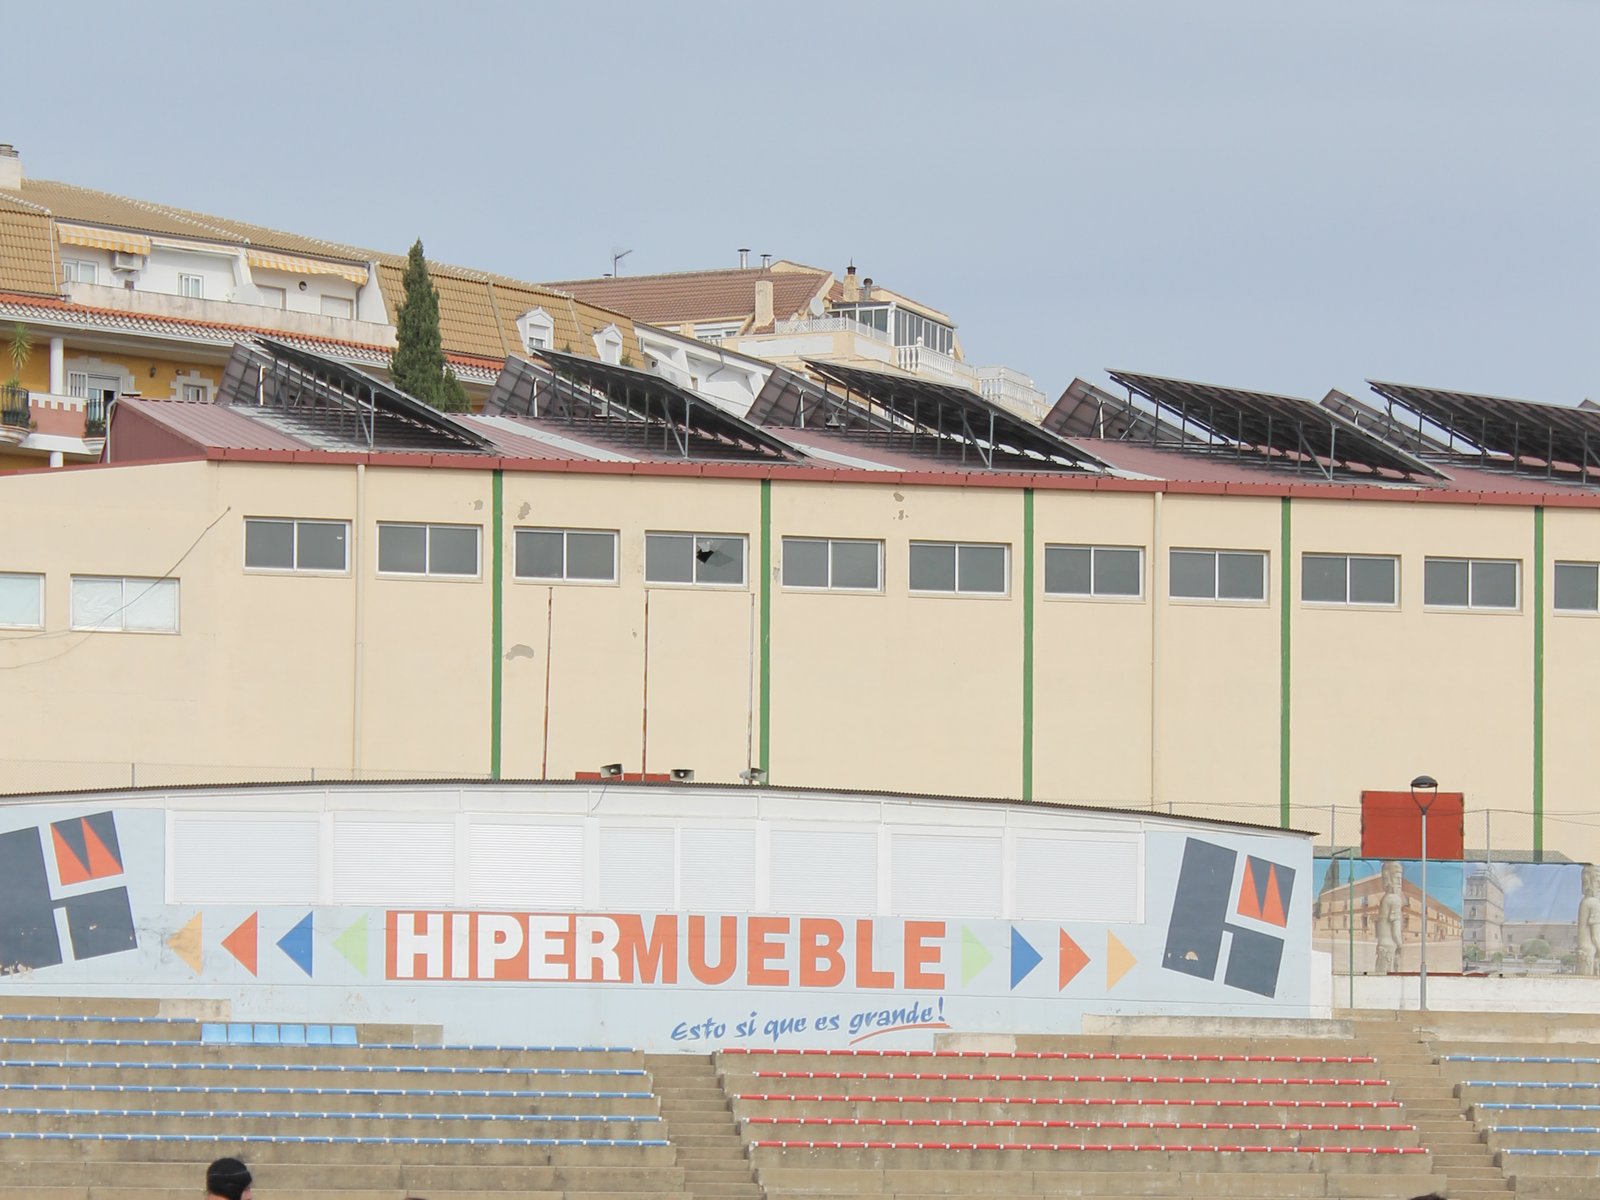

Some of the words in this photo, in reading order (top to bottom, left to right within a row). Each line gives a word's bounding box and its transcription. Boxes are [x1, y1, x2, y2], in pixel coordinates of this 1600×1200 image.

[386, 910, 945, 991] HIPERMUEBLE
[670, 1017, 726, 1041] Esto
[734, 1011, 757, 1038] si
[763, 1016, 807, 1042] que
[814, 1014, 840, 1031] es
[848, 996, 945, 1034] grande!
